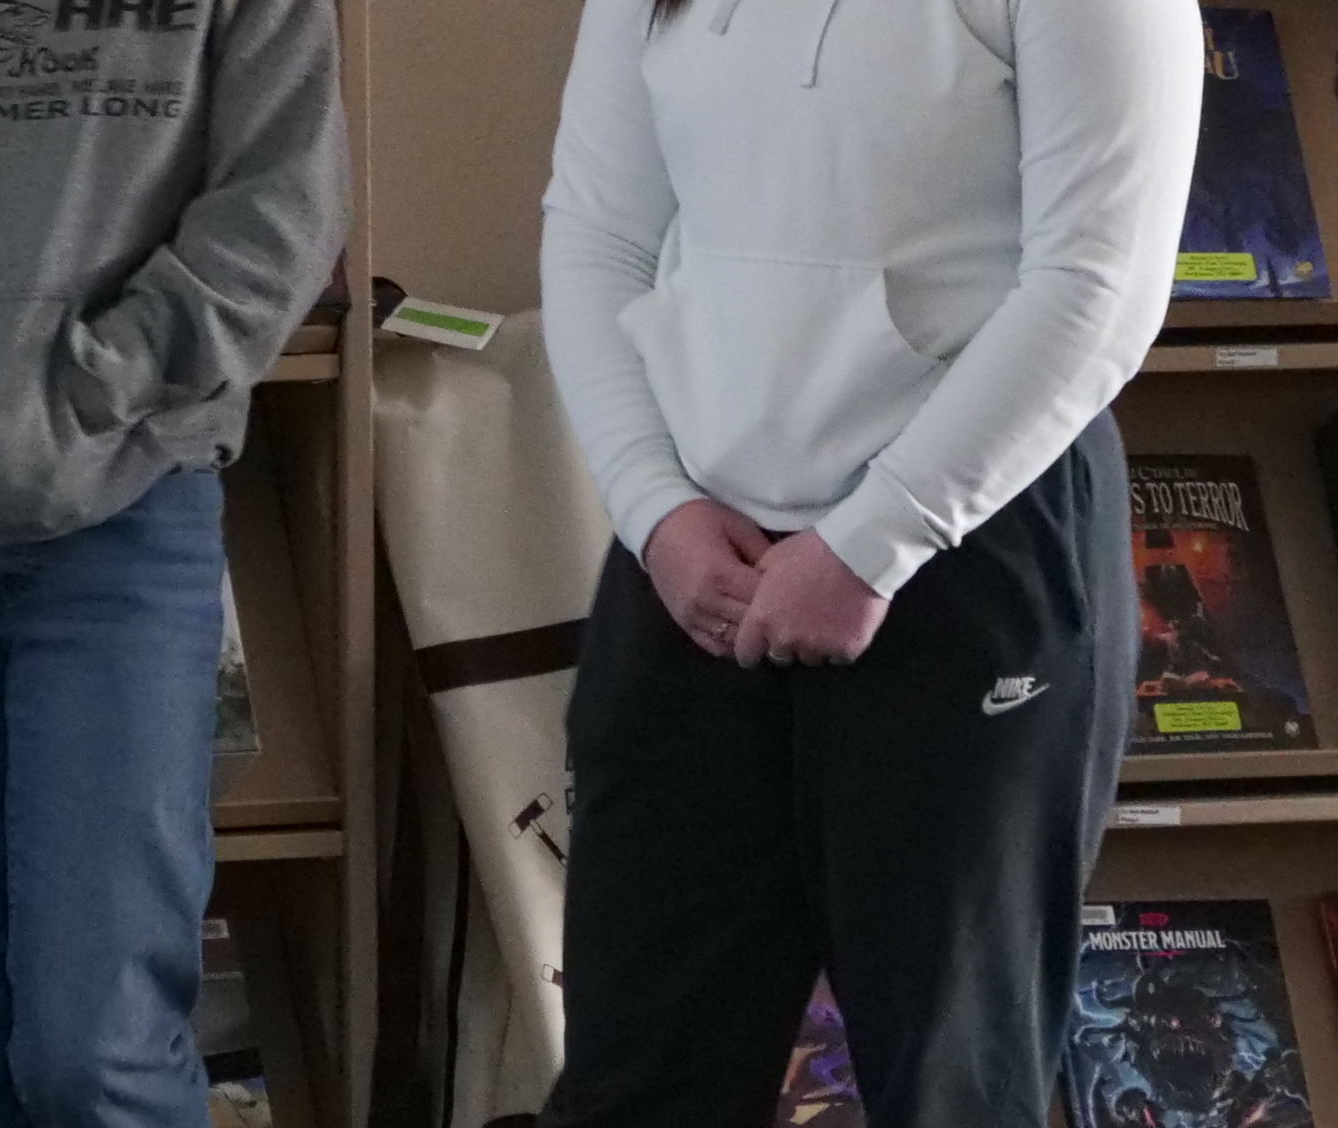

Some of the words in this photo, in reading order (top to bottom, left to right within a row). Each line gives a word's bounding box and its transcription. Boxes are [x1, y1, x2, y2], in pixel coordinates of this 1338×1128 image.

[82, 96, 183, 119] LONG
[1145, 481, 1174, 515] TO
[1172, 481, 1250, 532] TERROR
[1089, 930, 1160, 952] MONSTER
[1160, 929, 1227, 950] MANUAL
